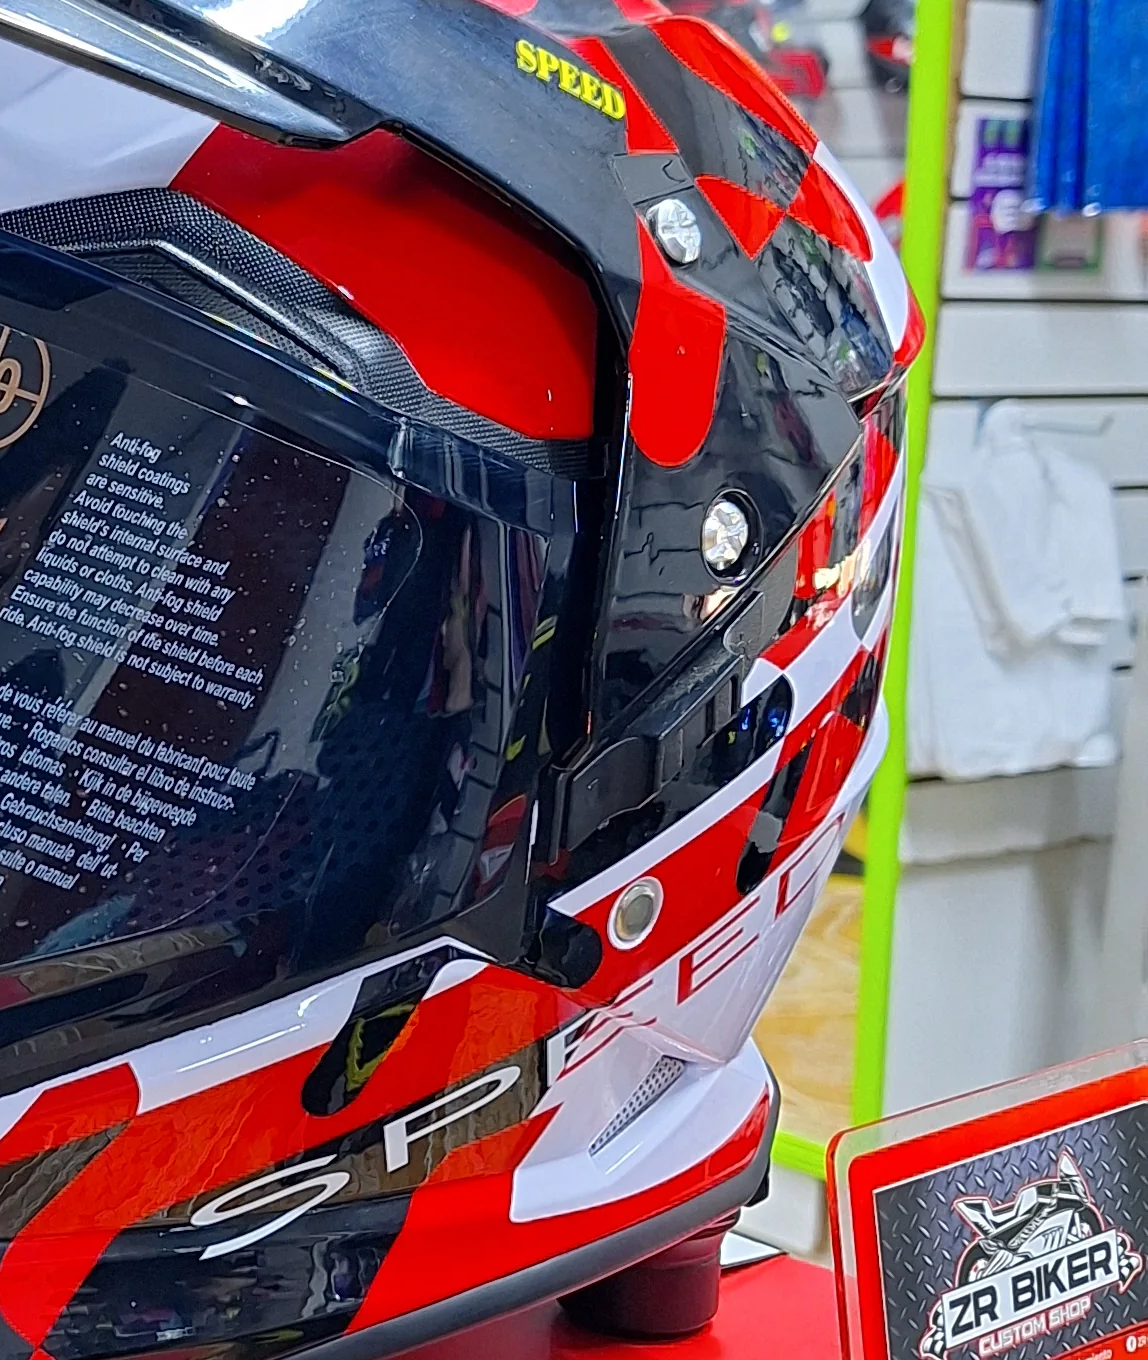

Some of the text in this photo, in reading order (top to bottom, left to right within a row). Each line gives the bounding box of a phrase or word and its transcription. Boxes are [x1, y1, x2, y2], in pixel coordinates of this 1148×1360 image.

[515, 39, 626, 120] SPEED
[99, 453, 191, 495] shield coatings
[110, 432, 161, 464] Anti-fog
[73, 490, 188, 540] Avoid touching the
[86, 474, 164, 509] are sensitive.
[49, 529, 235, 605] do not attempt to clean with any
[61, 511, 230, 577] shield's internal surface and
[23, 569, 219, 648] capability may decrease over time.
[36, 546, 224, 622] liquids or cloths. Anti-fog shield
[10, 584, 263, 685] Ensure the function of the shield before each
[26, 615, 255, 710] Anti-fog shield is not subject to warranty.
[13, 693, 44, 714] vous
[80, 717, 97, 734] au
[95, 726, 142, 750] manuel
[138, 738, 156, 756] du
[227, 768, 256, 792] toute
[20, 745, 67, 777] idiomas
[114, 785, 133, 803] de
[28, 721, 84, 756] Rogamos
[83, 745, 135, 777] consultar
[148, 767, 175, 791] libro
[174, 776, 191, 797] de
[0, 770, 40, 795] andere
[85, 799, 116, 823] Bitte
[113, 809, 166, 843] beachten
[25, 829, 75, 860] manuale
[34, 862, 81, 891] manual
[124, 841, 149, 864] Per
[189, 814, 844, 1261] SPEED
[948, 1240, 1113, 1338] ZR BIKER
[979, 1295, 1092, 1356] CUSTOM SHOP
